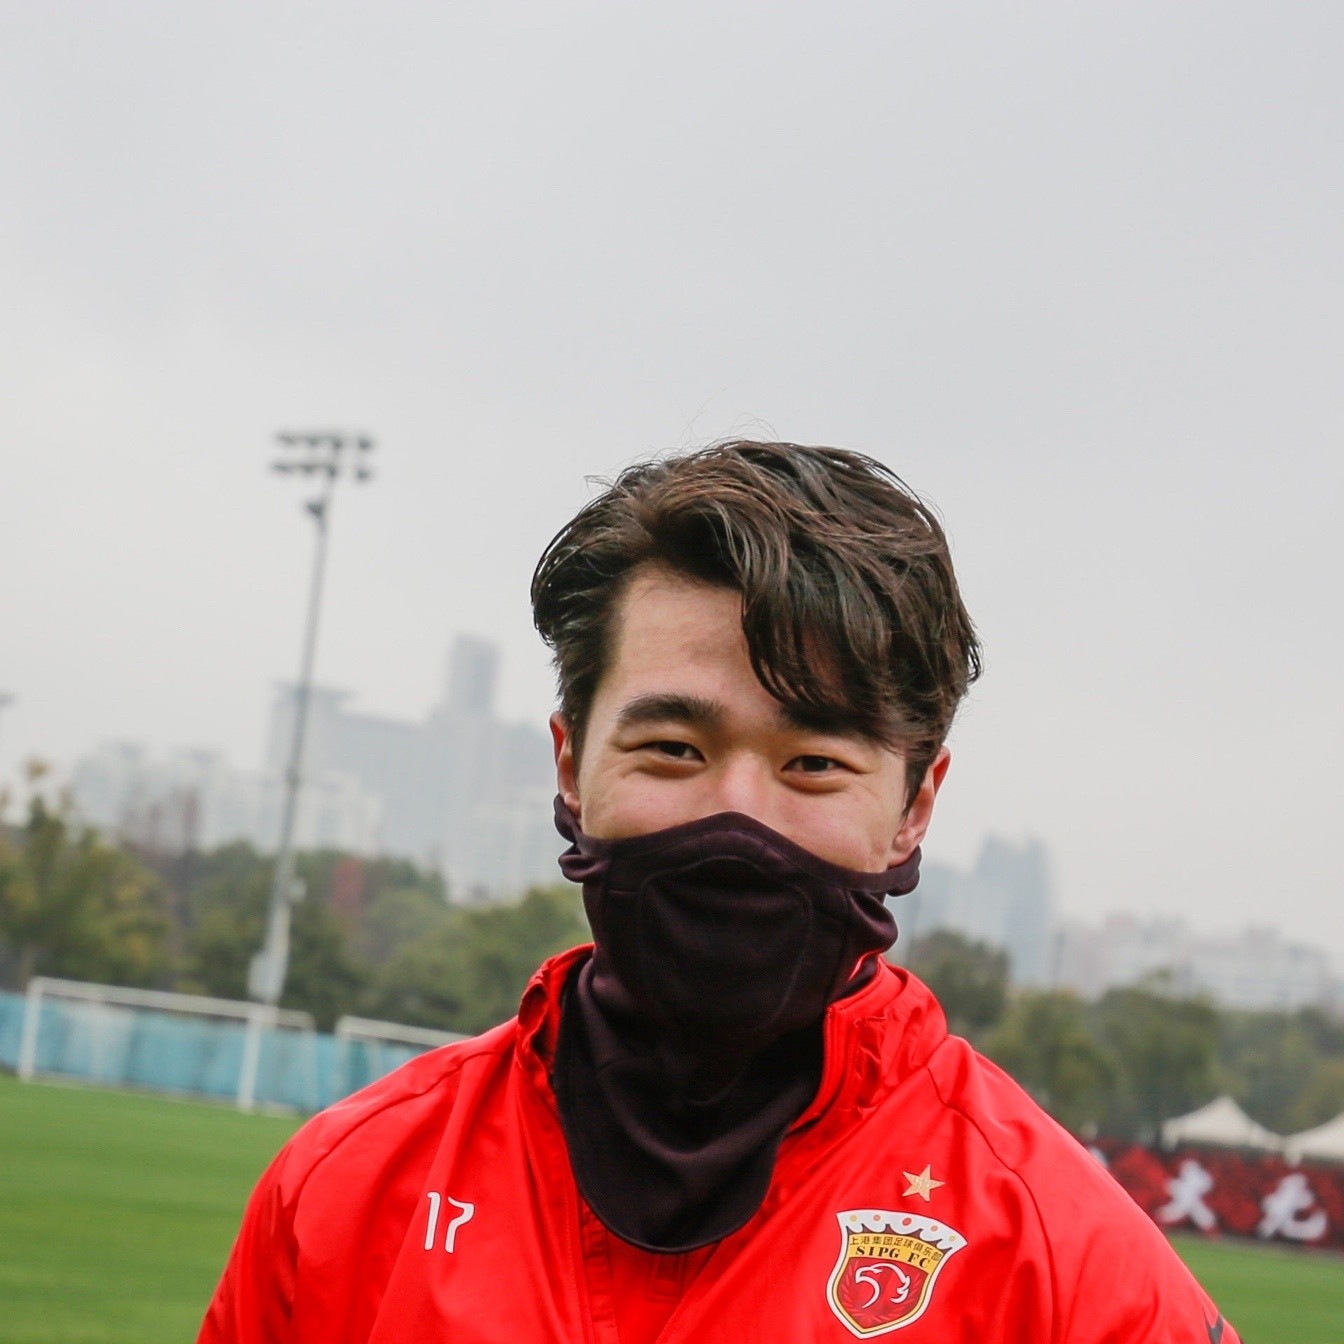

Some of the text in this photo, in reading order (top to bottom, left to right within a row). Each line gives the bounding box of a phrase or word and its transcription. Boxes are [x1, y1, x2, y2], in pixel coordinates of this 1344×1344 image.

[424, 1191, 475, 1254] 17
[849, 1235, 943, 1262] 上港集团足球俱乐部
[855, 1245, 931, 1269] SIPG FC
